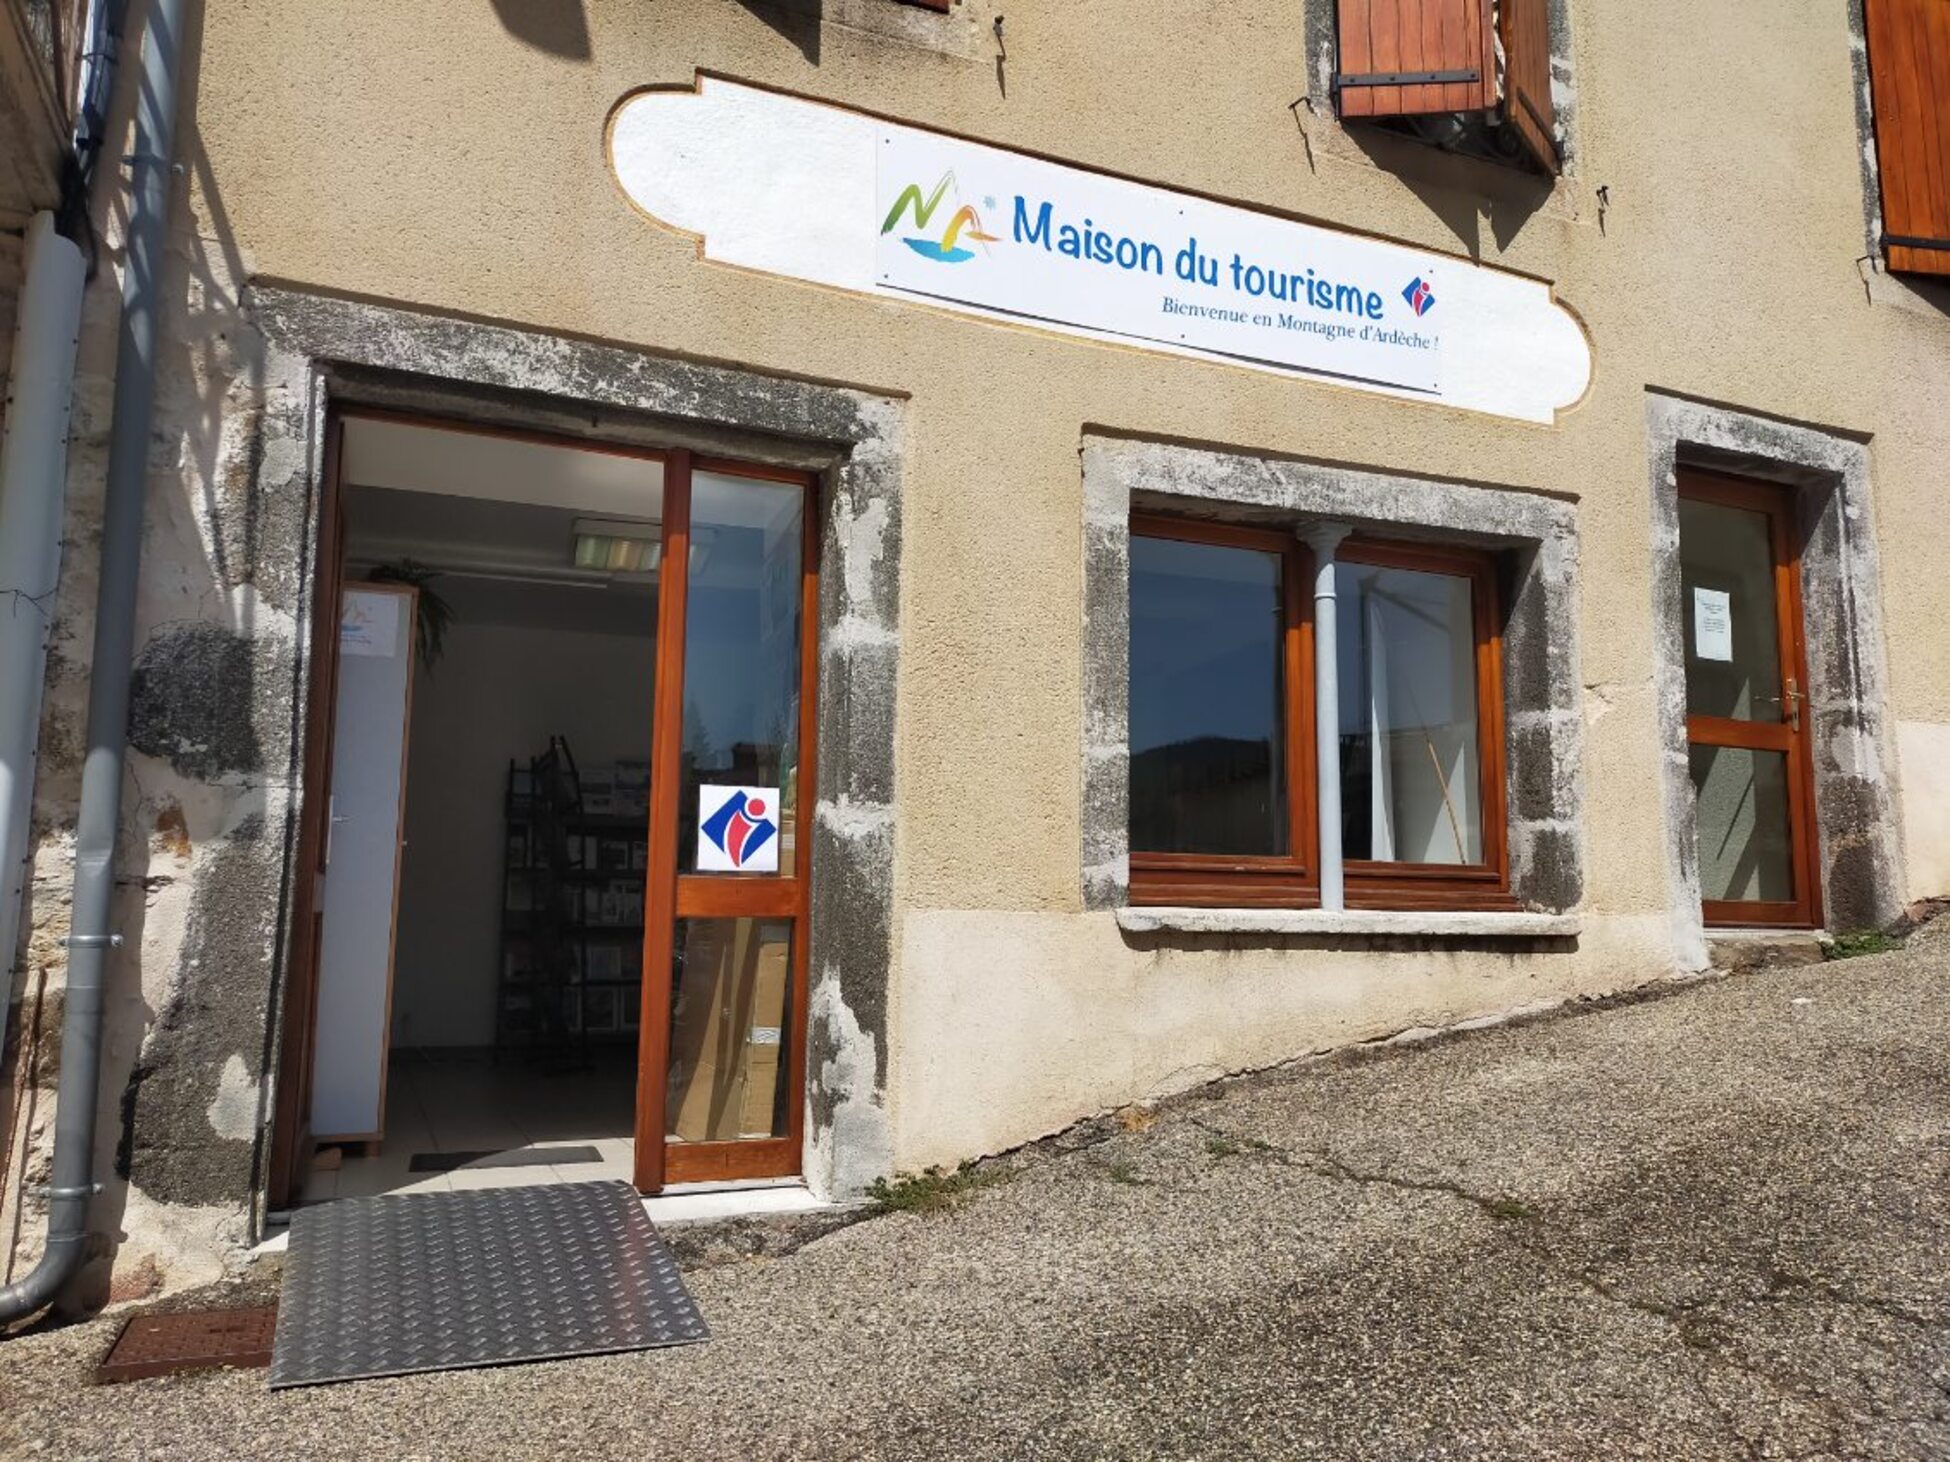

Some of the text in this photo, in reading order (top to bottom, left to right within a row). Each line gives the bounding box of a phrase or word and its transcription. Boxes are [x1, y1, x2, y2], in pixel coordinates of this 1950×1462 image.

[1013, 195, 1385, 321] Maison du tourisme
[1162, 296, 1248, 323] Bienvenue
[1252, 314, 1272, 327] en
[1277, 313, 1356, 341] Montagne
[1359, 325, 1431, 350] d'Ardèche
